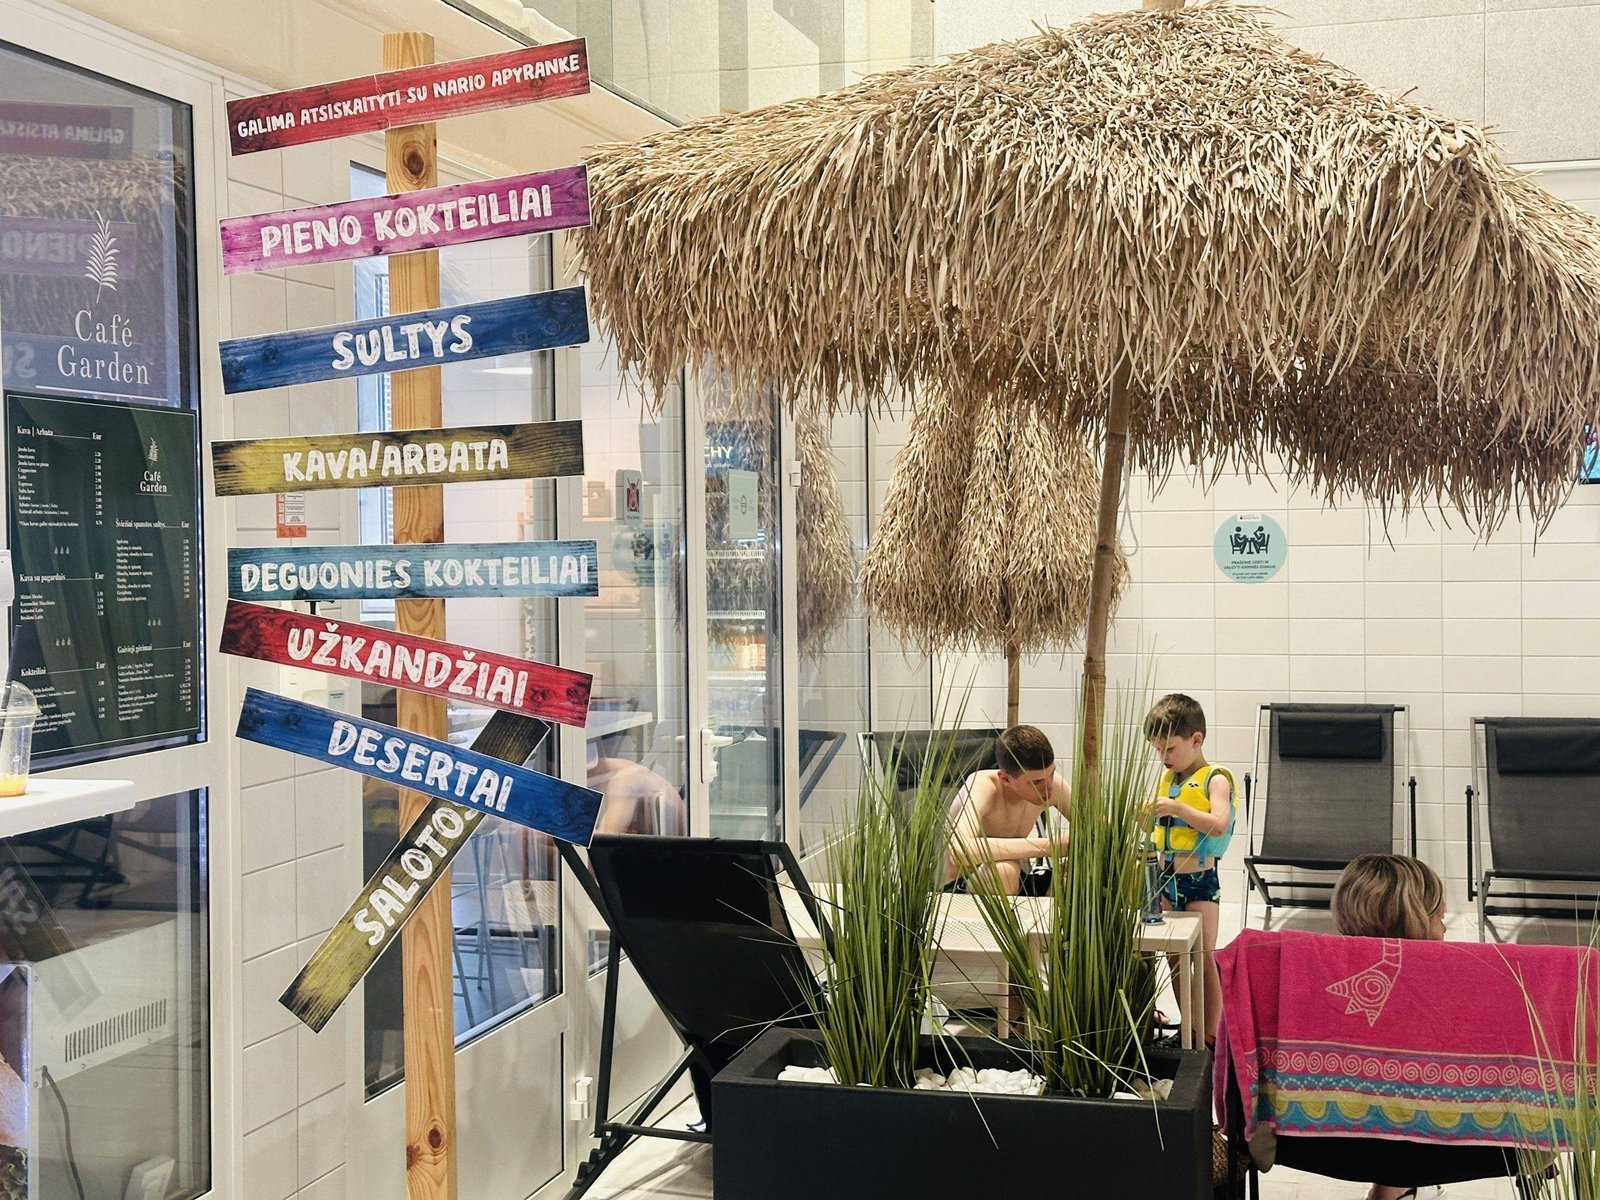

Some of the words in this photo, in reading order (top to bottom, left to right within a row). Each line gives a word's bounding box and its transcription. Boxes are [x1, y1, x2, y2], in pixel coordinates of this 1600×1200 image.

[237, 112, 295, 138] GALIMA
[300, 89, 400, 126] ATSISKAITYTI
[406, 85, 428, 104] SU
[433, 74, 486, 98] NARIO
[491, 54, 580, 87] APYRANKE
[260, 213, 363, 257] PIENO
[373, 184, 552, 242] KOKTEILIAI
[74, 309, 133, 348] Café
[331, 314, 473, 370] SULTYS
[57, 344, 149, 386] Garden
[143, 470, 162, 482] Café
[282, 438, 509, 482] KAVA/ARBATA
[139, 481, 168, 493] Garden
[241, 558, 411, 592] DEGUONIES
[423, 554, 589, 586] KOKTEILIAI
[286, 621, 528, 707] UŽKANDŽIAI
[327, 719, 514, 812] DESERTAI
